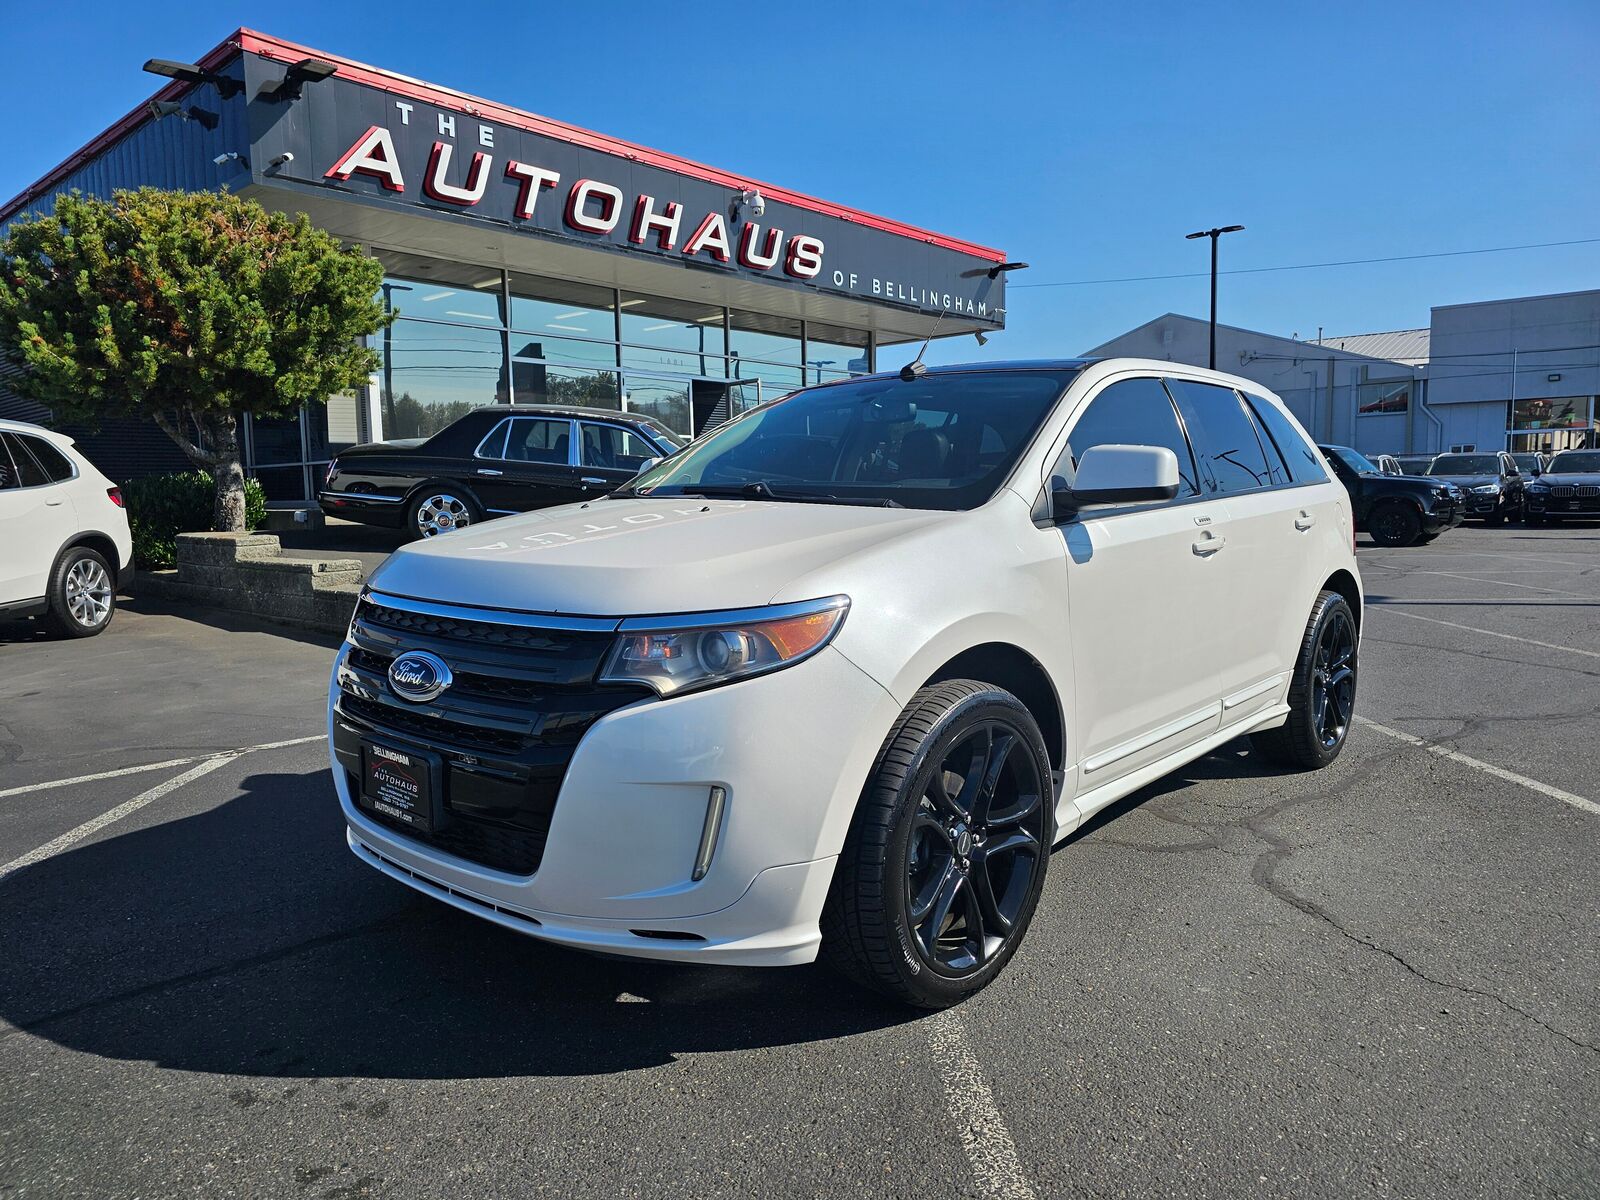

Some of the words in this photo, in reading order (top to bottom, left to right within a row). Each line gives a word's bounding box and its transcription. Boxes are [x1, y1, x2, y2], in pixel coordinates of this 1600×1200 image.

[396, 101, 494, 149] THE
[324, 125, 825, 279] AUTOHAUS
[833, 270, 858, 288] OF
[872, 278, 987, 316] BELLINGHAM
[394, 660, 427, 686] Ford
[374, 771, 418, 793] AUTOHAUS
